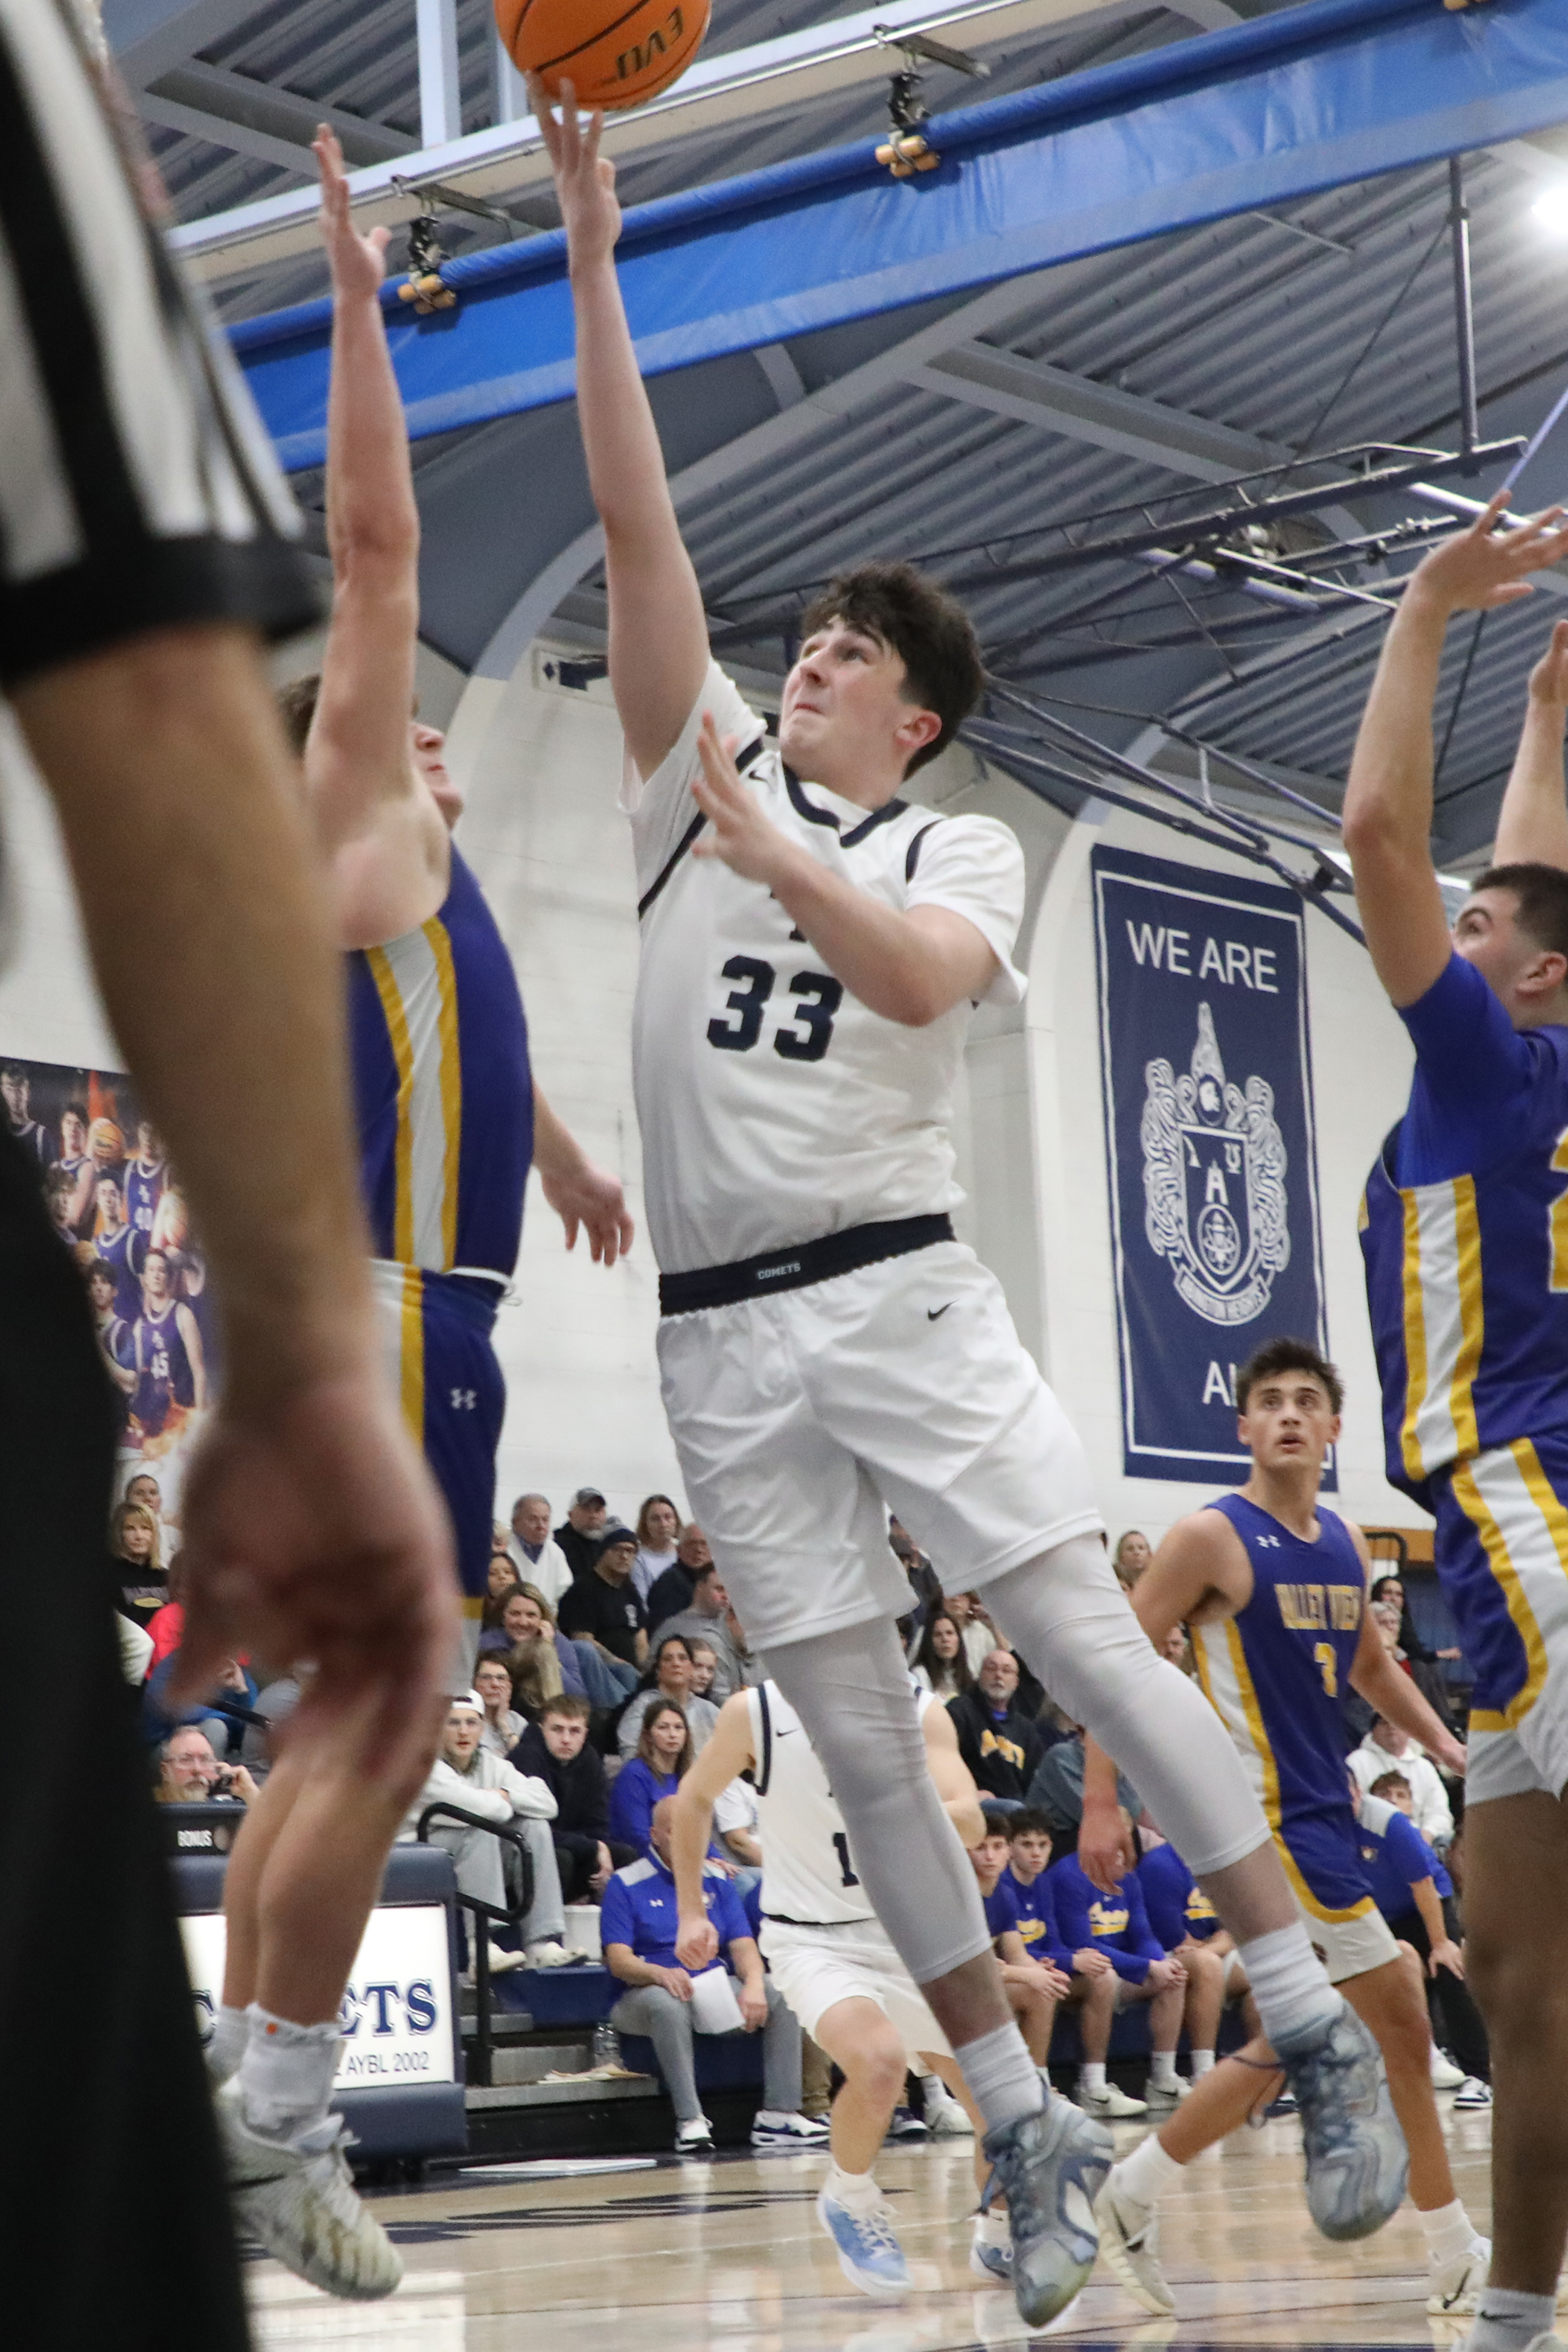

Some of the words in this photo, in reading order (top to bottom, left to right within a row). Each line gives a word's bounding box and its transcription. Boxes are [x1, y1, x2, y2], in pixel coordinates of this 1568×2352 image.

[1126, 919, 1192, 977] WE
[1199, 937, 1279, 994] ARE
[706, 954, 844, 1062] 33
[757, 1262, 801, 1279] COMETS
[177, 1829, 212, 1848] BONUS
[347, 2053, 390, 2076] AYBL
[394, 2051, 430, 2072] 2002
